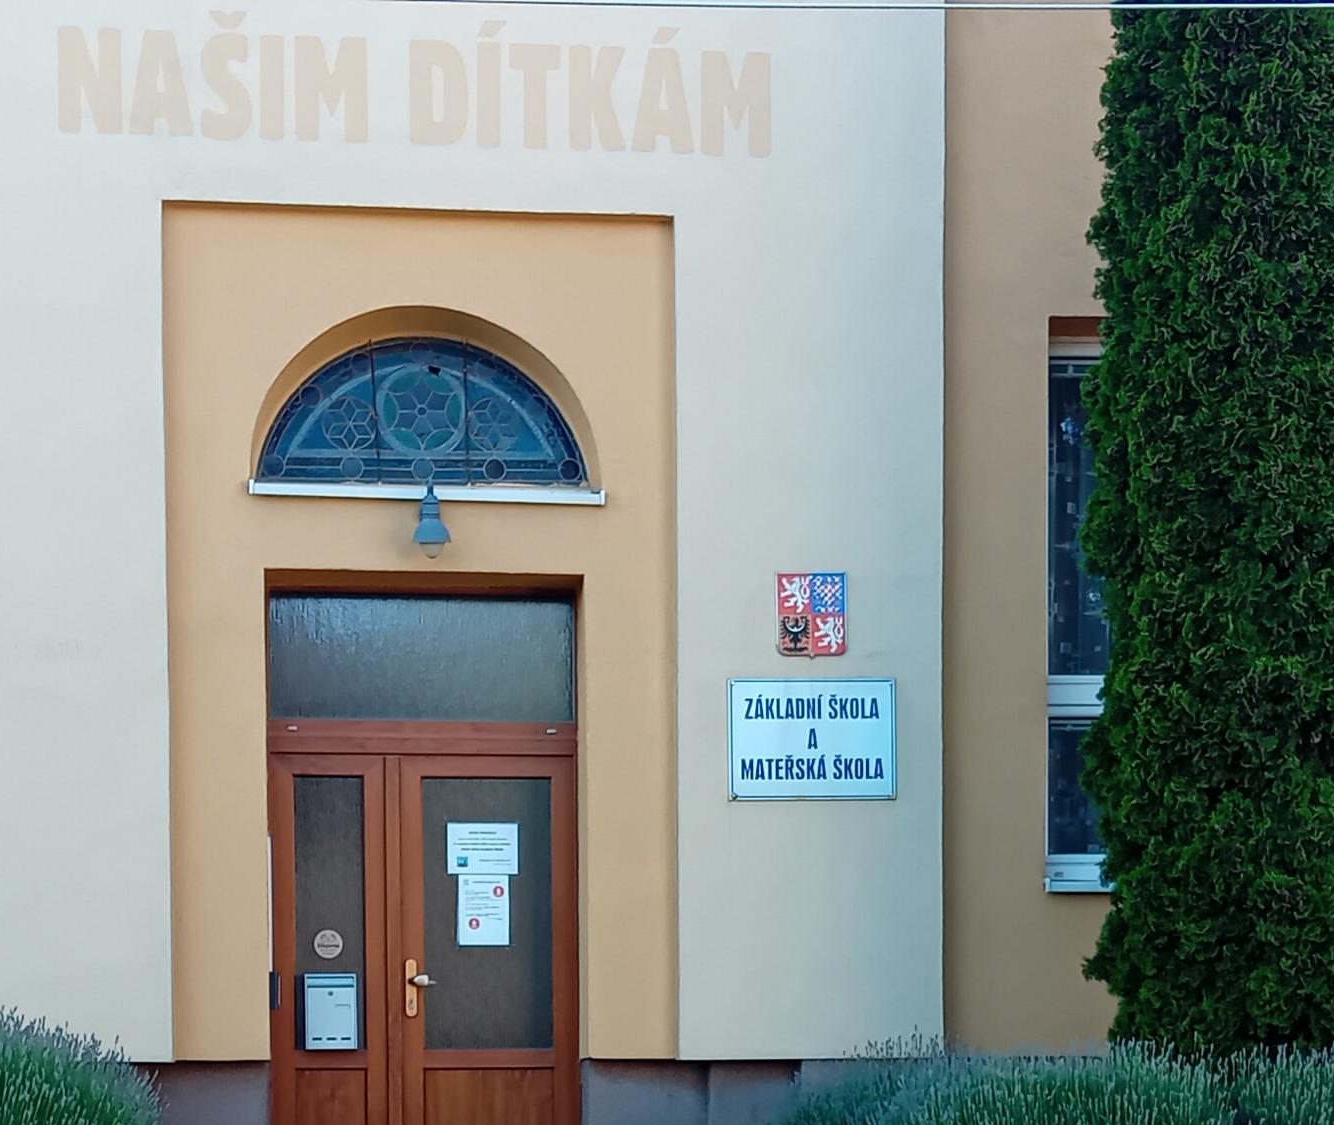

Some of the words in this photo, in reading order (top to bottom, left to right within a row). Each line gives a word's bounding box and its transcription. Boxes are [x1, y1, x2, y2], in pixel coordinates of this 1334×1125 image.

[57, 10, 367, 143] NAŠIM
[409, 20, 772, 158] DÍTKÁM
[744, 694, 823, 719] ZÁKLADNÍ
[828, 694, 880, 719] ŠKOLA
[807, 728, 818, 750] A
[740, 755, 827, 780] MATEŘSKÁ
[833, 755, 884, 780] ŠKOLA
